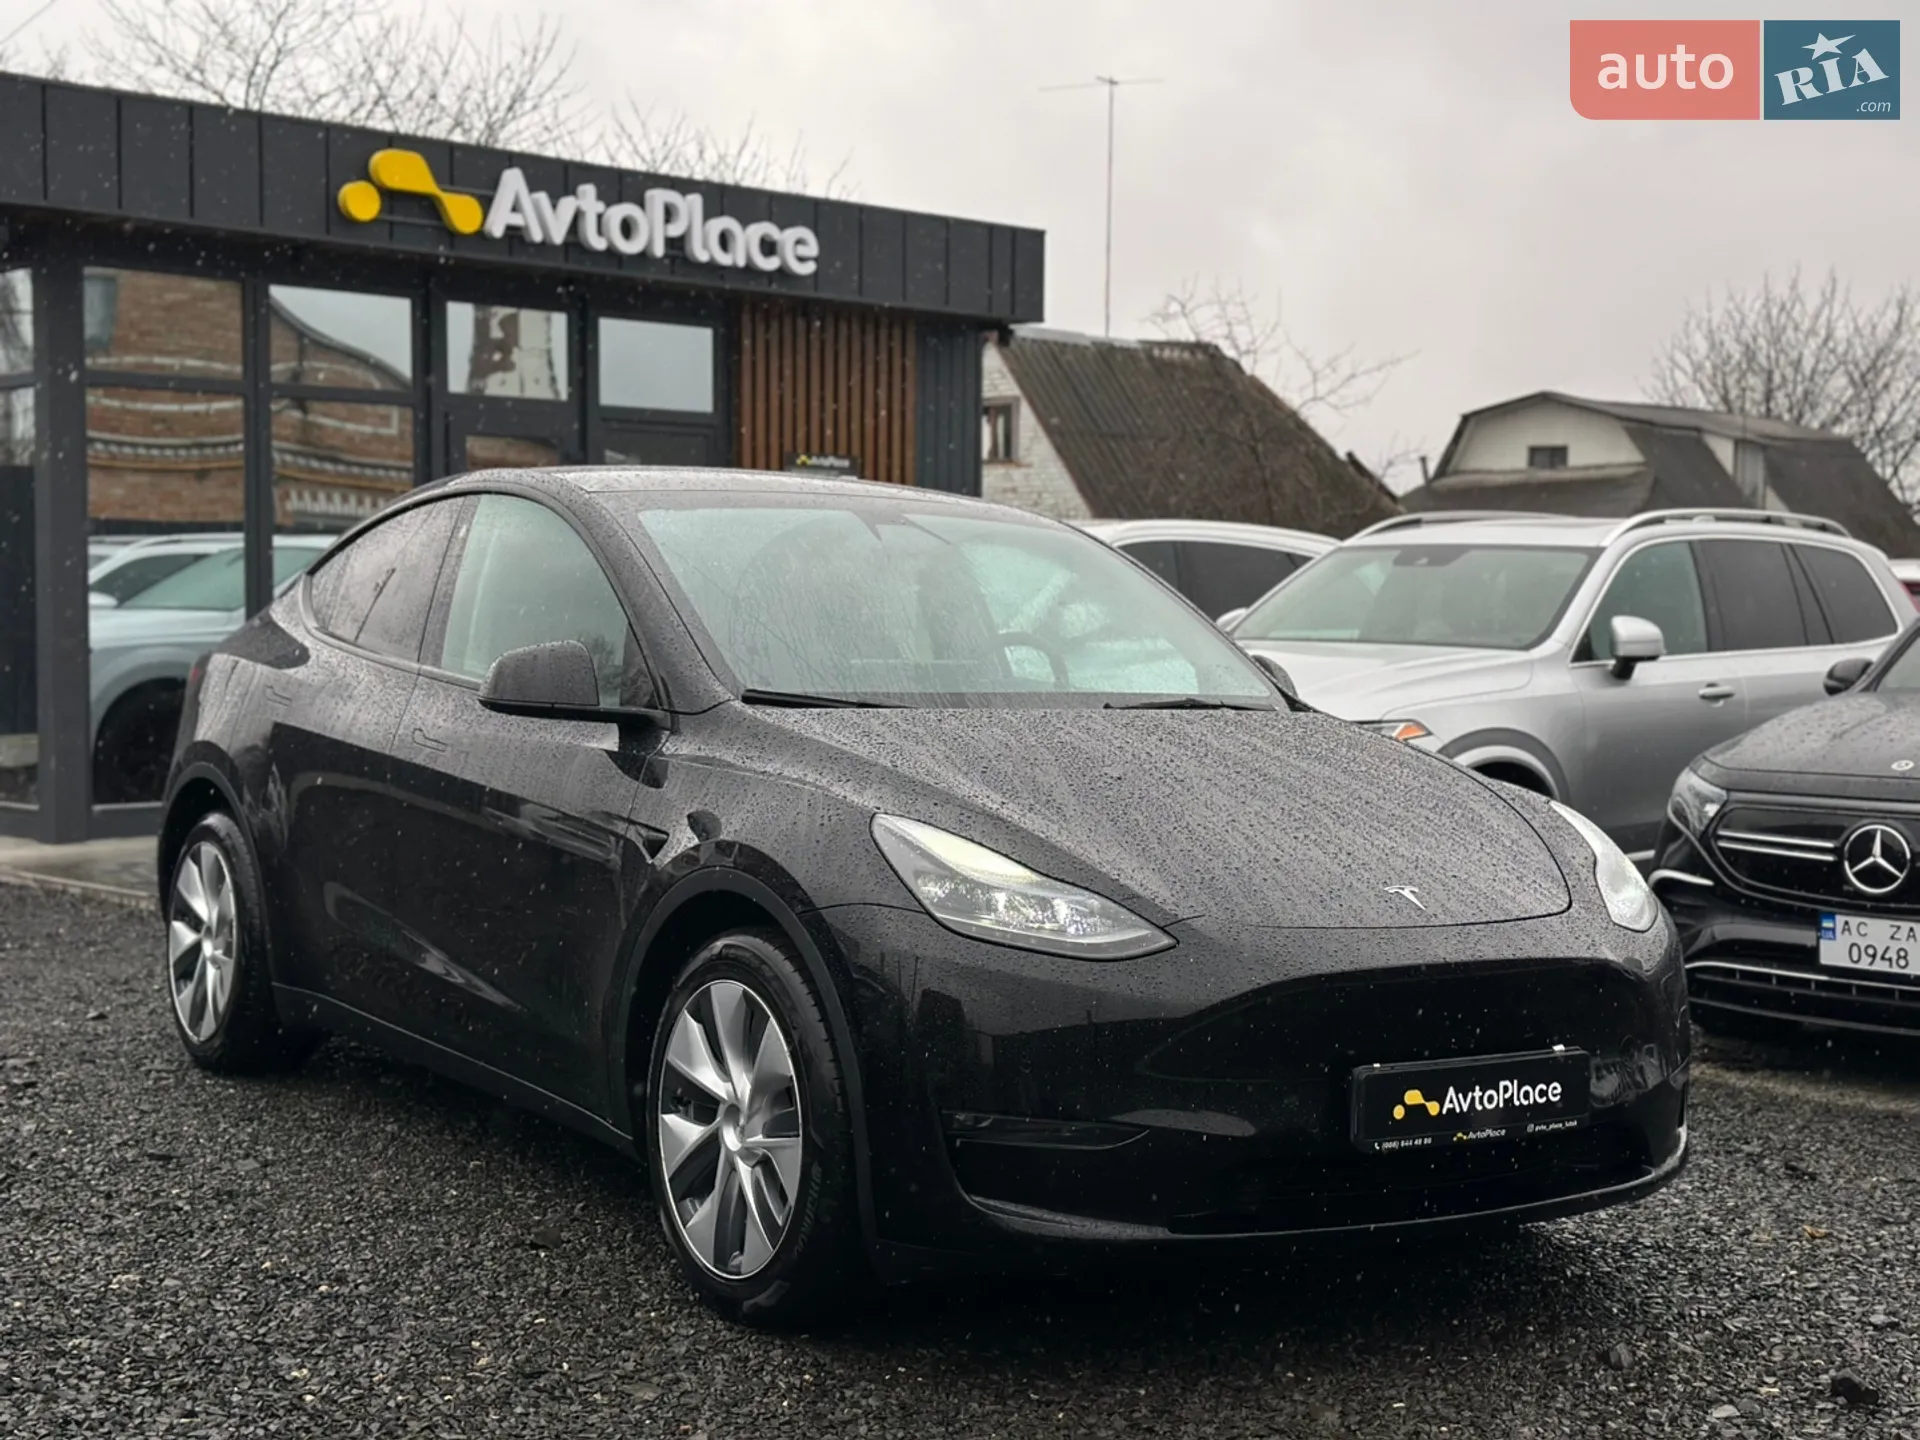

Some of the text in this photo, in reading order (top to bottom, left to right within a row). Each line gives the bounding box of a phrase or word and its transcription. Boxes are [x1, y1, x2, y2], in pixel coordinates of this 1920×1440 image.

[484, 166, 820, 276] AvtoPlace
[1841, 920, 1917, 943] AC ZA
[1848, 942, 1910, 970] 0948
[1441, 1079, 1563, 1115] AvtoPlace
[1467, 1128, 1506, 1140] AvtoPlace
